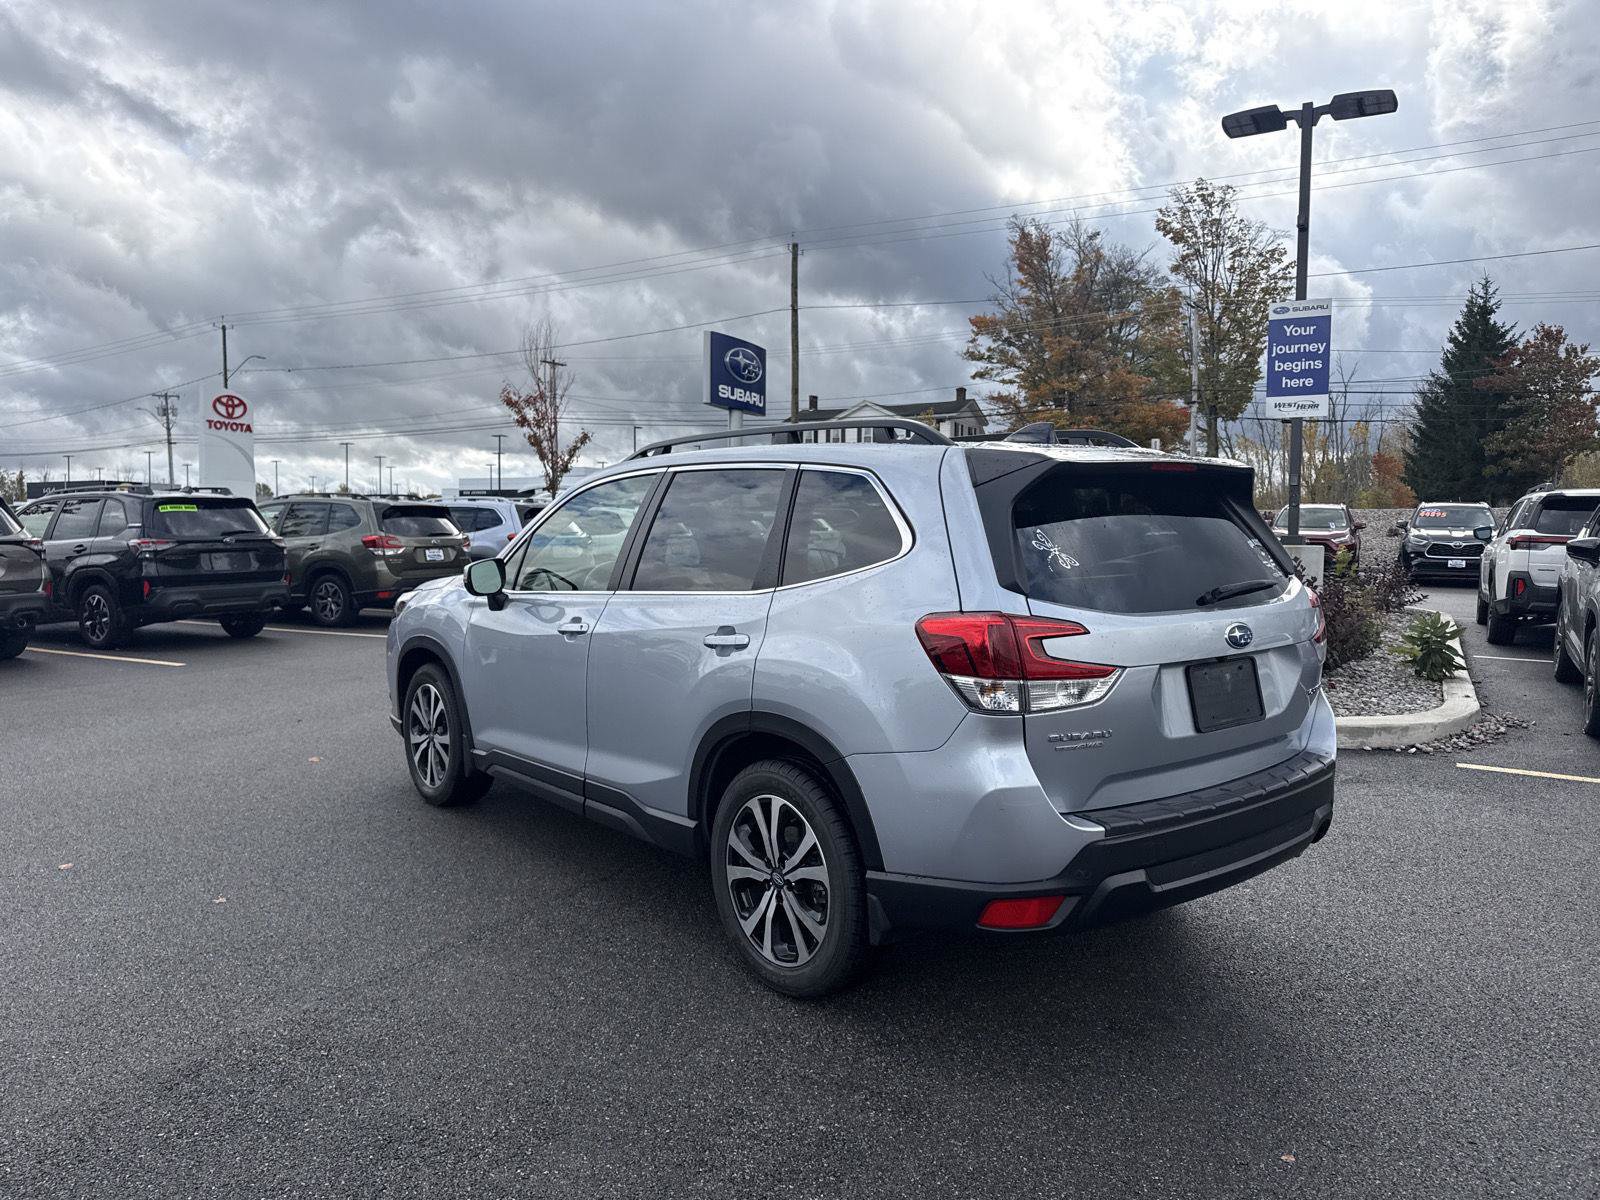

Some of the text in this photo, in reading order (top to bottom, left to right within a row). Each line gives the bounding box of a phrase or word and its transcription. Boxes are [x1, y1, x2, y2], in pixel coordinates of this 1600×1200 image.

[1292, 304, 1329, 312] SUBARU
[1283, 324, 1316, 337] Your
[1271, 342, 1327, 357] journey
[1274, 358, 1323, 373] begins
[1281, 376, 1314, 388] here
[718, 384, 764, 408] SUBARU
[1274, 402, 1320, 410] WEST HERR
[206, 419, 253, 433] TOYOTA
[1048, 729, 1113, 743] SUBARU
